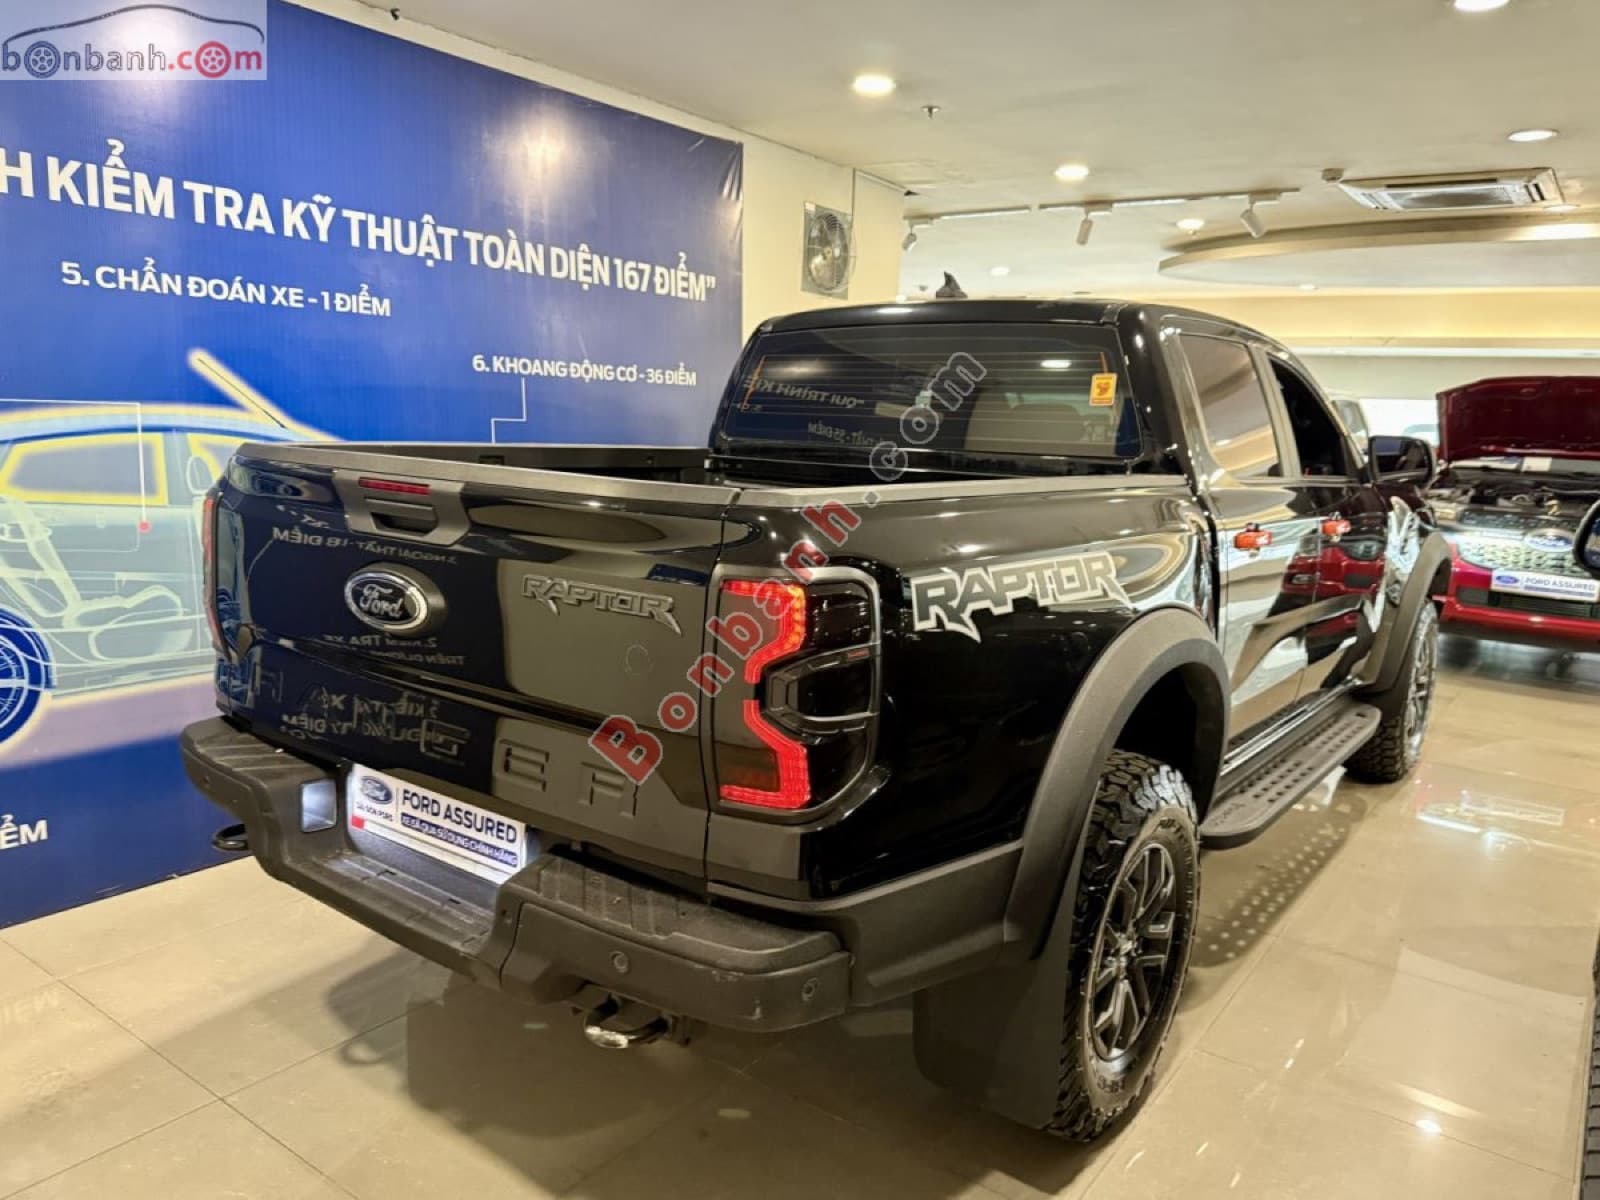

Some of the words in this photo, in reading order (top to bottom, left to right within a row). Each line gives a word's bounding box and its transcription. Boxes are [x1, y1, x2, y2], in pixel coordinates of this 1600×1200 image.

[47, 139, 175, 219] KIỂM
[182, 180, 275, 235] TRA
[282, 193, 336, 243] KỸ
[342, 207, 459, 267] THUẬT
[463, 229, 545, 276] TOÀN
[550, 244, 610, 290] DIỆN
[614, 259, 651, 292] 167
[61, 260, 90, 286] 5.
[95, 256, 182, 296] CHẨN
[187, 276, 265, 305] ĐOÁN
[271, 284, 304, 308] XE
[321, 291, 330, 310] 1
[335, 283, 391, 317] ĐIỂM
[472, 354, 490, 373] 6.
[492, 355, 567, 379] KHOANG
[568, 359, 615, 384] ĐỘNG
[616, 364, 638, 382] CƠ
[646, 368, 664, 384] 36
[665, 361, 697, 386] ĐIỂM
[521, 573, 683, 635] RAPTOR
[910, 550, 1138, 645] RAPTOR
[402, 789, 440, 817] FORD
[443, 807, 517, 844] ASSURED
